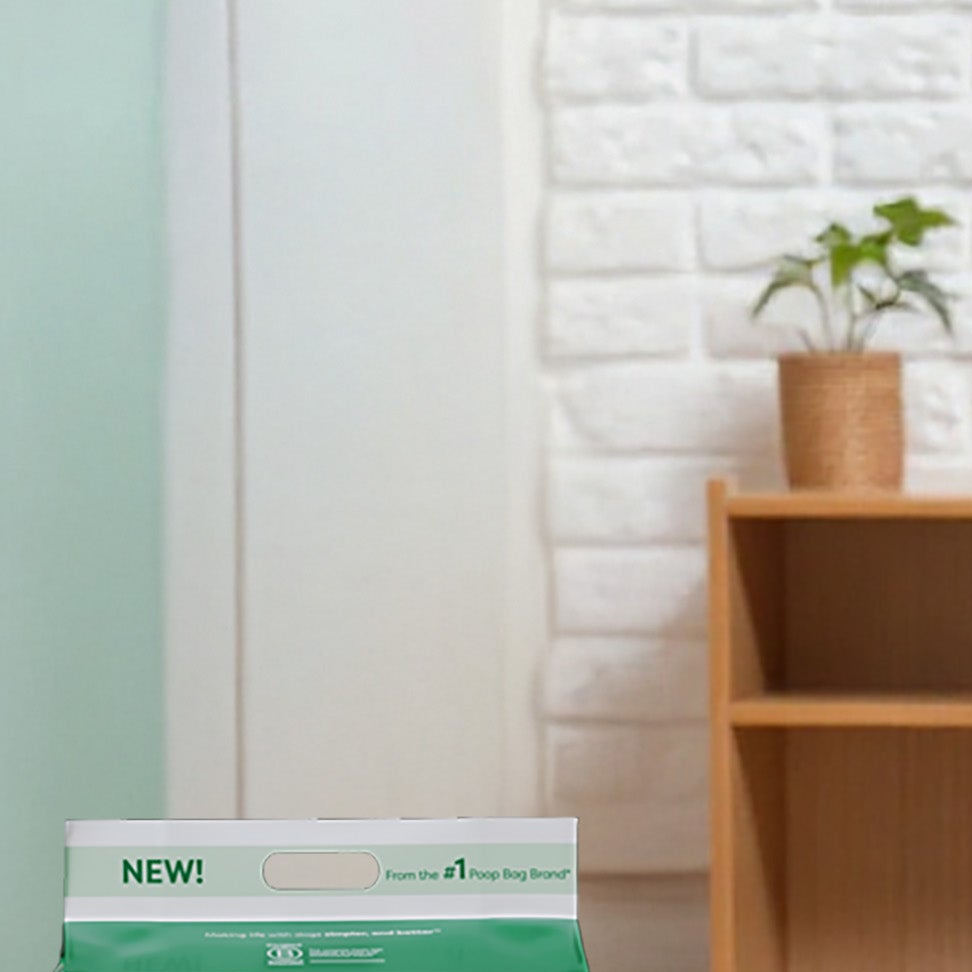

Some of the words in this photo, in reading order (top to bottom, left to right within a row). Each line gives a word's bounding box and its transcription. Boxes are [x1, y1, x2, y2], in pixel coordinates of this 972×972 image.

[123, 859, 204, 884] NEW!
[385, 869, 417, 881] From
[418, 869, 440, 881] the
[443, 857, 466, 880] #1
[469, 868, 501, 882] Poop
[502, 867, 528, 882] Bag
